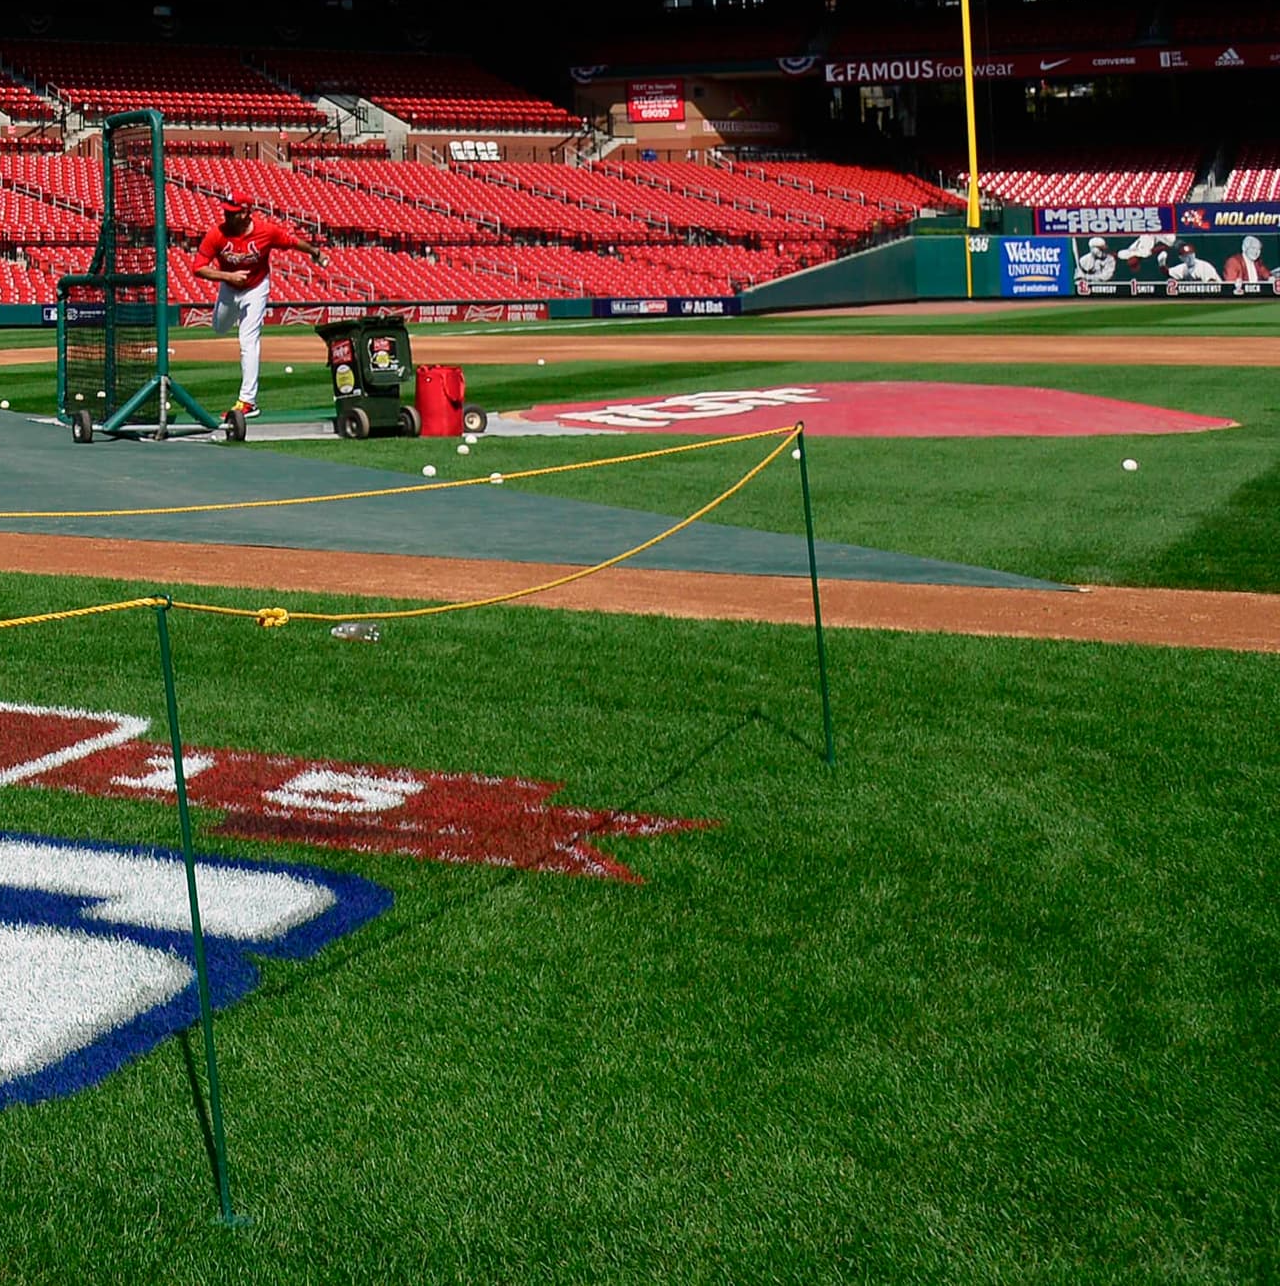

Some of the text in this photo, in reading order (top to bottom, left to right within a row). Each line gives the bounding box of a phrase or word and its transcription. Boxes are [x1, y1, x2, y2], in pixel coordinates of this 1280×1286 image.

[846, 60, 1014, 82] FAMOUS foowear
[1068, 219, 1162, 233] HOMES
[1004, 242, 1061, 263] Webster
[1008, 263, 1061, 277] UNIVERSITY
[1166, 280, 1178, 295] 2
[693, 300, 723, 313] At Bat
[111, 752, 426, 814] 15
